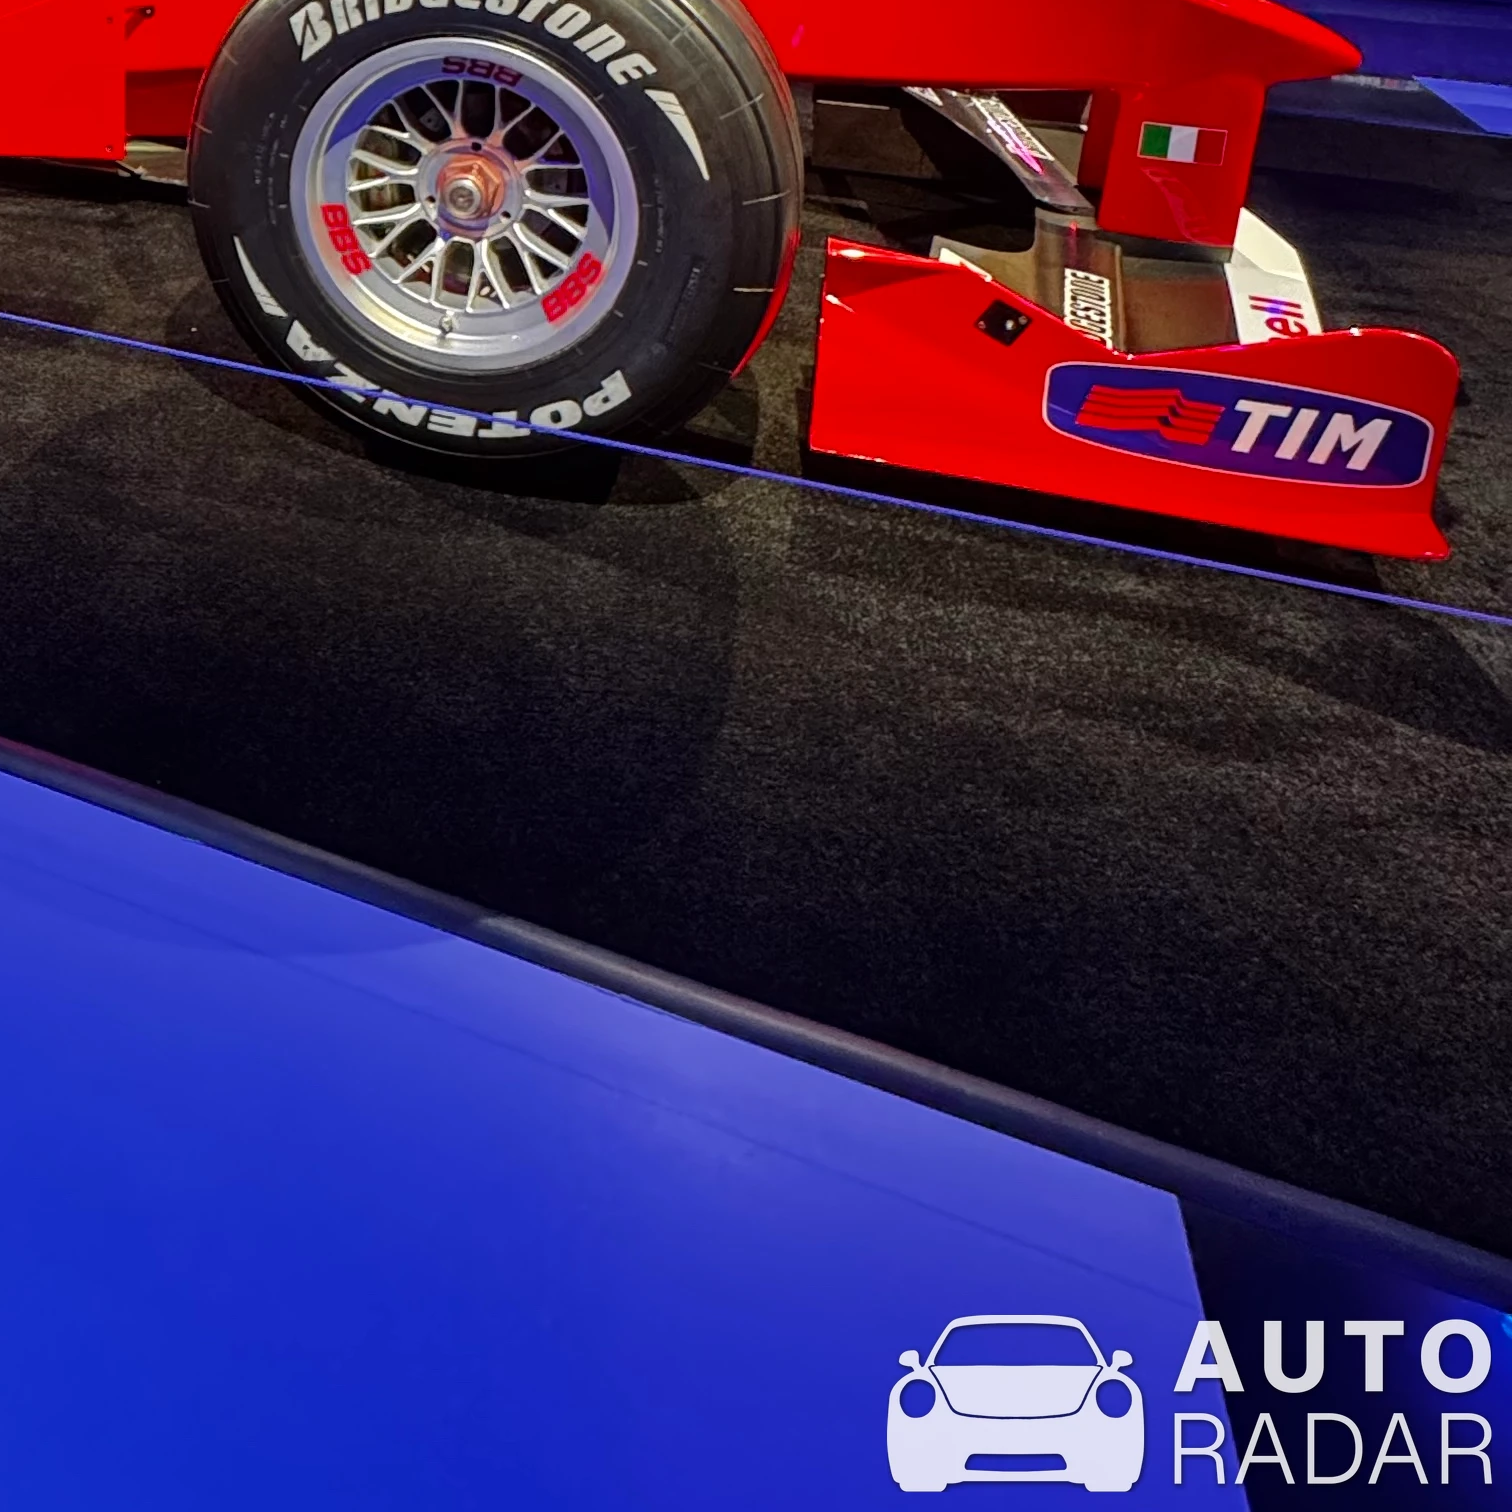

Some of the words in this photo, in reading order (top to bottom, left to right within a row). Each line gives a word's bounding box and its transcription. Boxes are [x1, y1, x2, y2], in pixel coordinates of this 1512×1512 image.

[442, 56, 524, 87] BBS
[320, 203, 373, 276] BBS
[541, 252, 602, 323] BBS
[1248, 295, 1309, 343] ell
[286, 319, 632, 438] POTENZA
[1231, 400, 1392, 471] TIM
